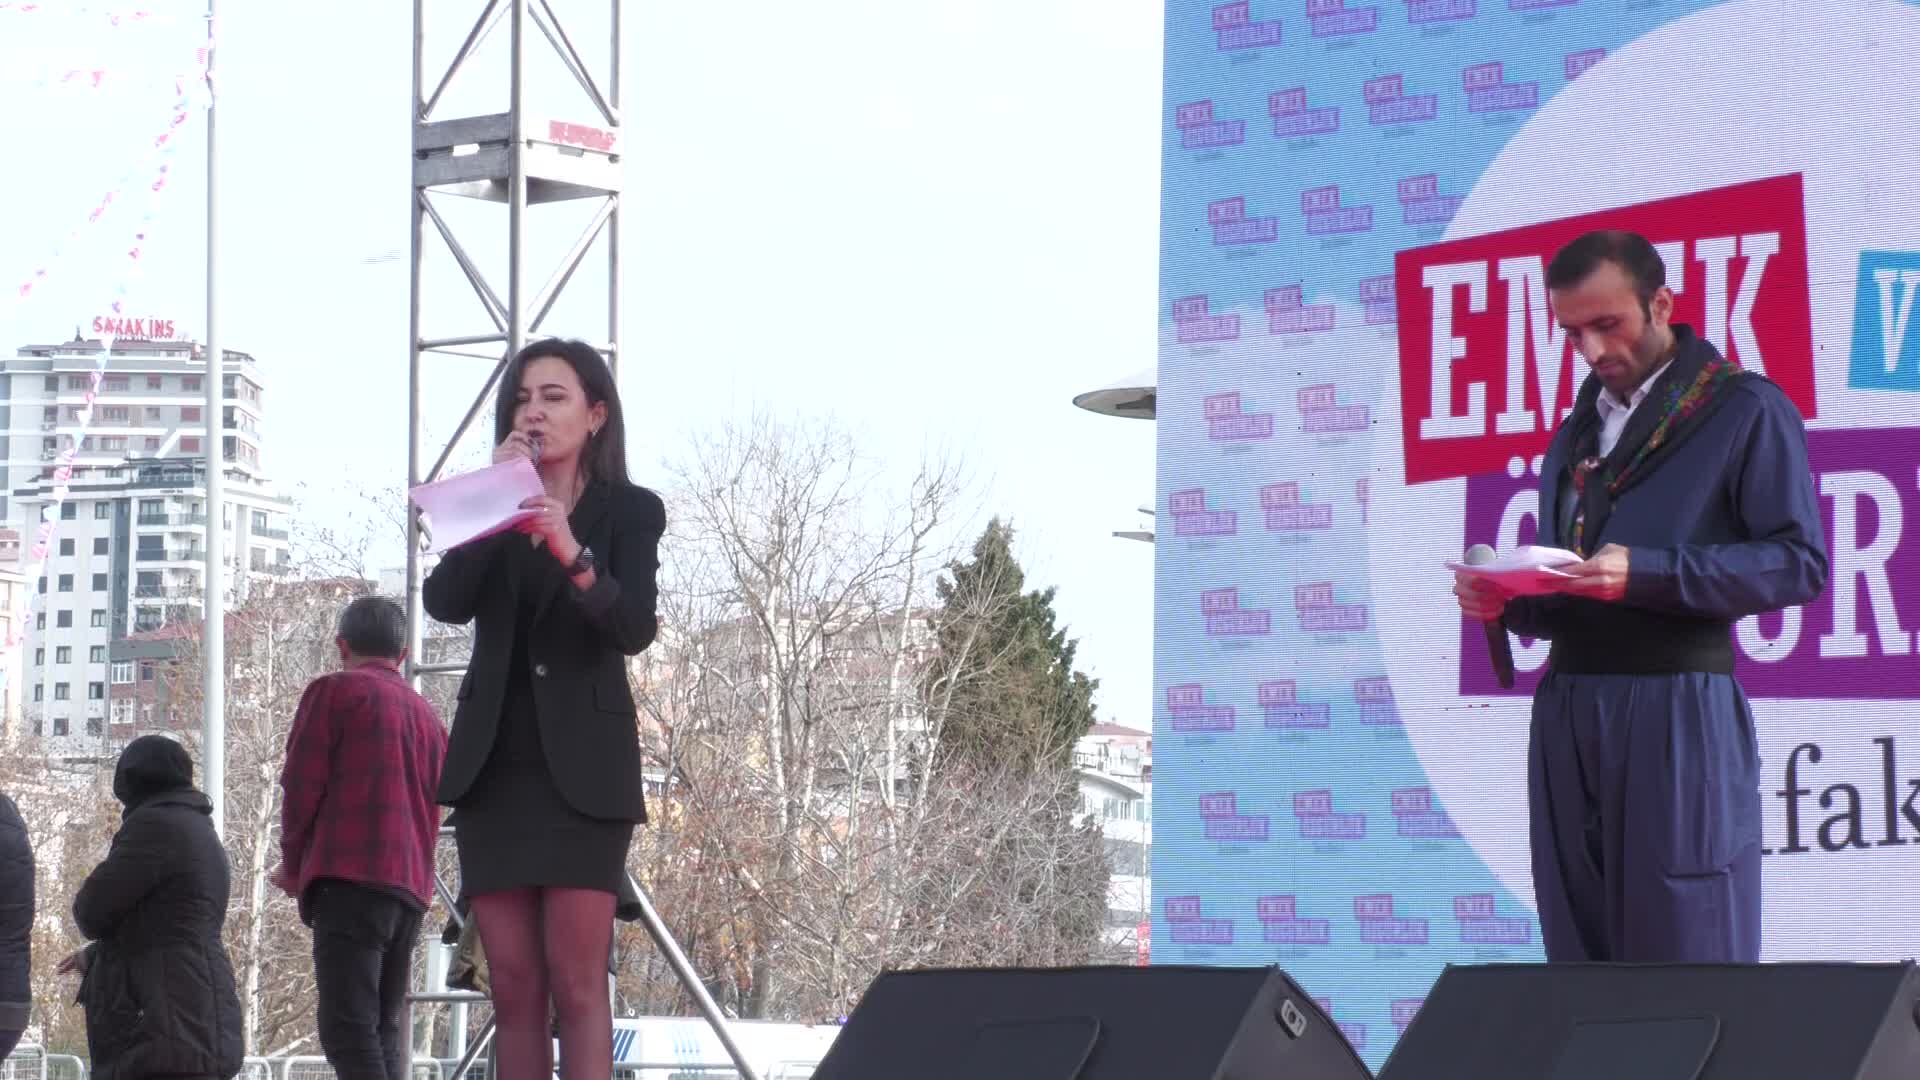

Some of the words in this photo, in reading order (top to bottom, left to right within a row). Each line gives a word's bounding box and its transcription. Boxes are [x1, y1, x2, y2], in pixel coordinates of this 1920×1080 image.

[1420, 232, 1779, 441] EMK
[1873, 270, 1920, 372] V
[1761, 735, 1920, 855] fak
